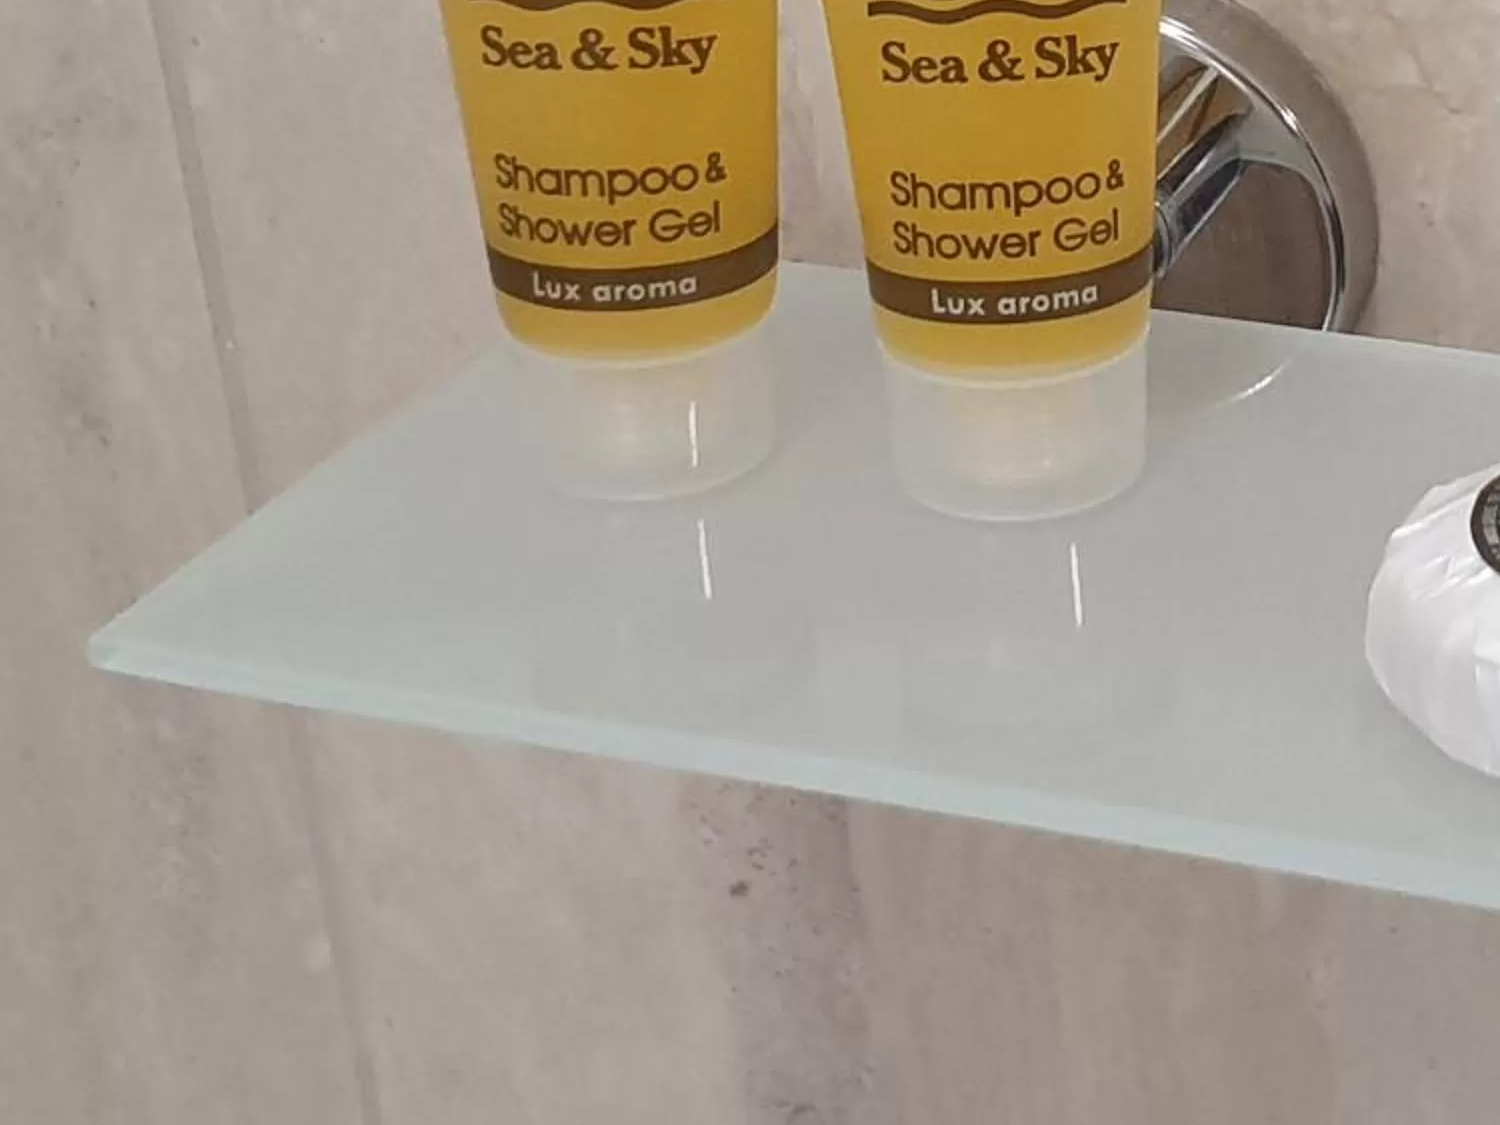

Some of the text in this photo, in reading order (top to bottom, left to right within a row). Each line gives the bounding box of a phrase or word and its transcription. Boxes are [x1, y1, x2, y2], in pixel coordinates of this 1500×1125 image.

[480, 25, 718, 74] Sea & Sky
[881, 34, 1120, 84] Sea & Sky
[494, 151, 727, 205] Shampoo &
[890, 159, 1124, 217] Shampoo &
[499, 200, 721, 246] Shower Gel
[893, 207, 1119, 259] Shower Gel
[533, 271, 698, 303] Lux aroma
[931, 284, 1098, 316] Lux aroma
